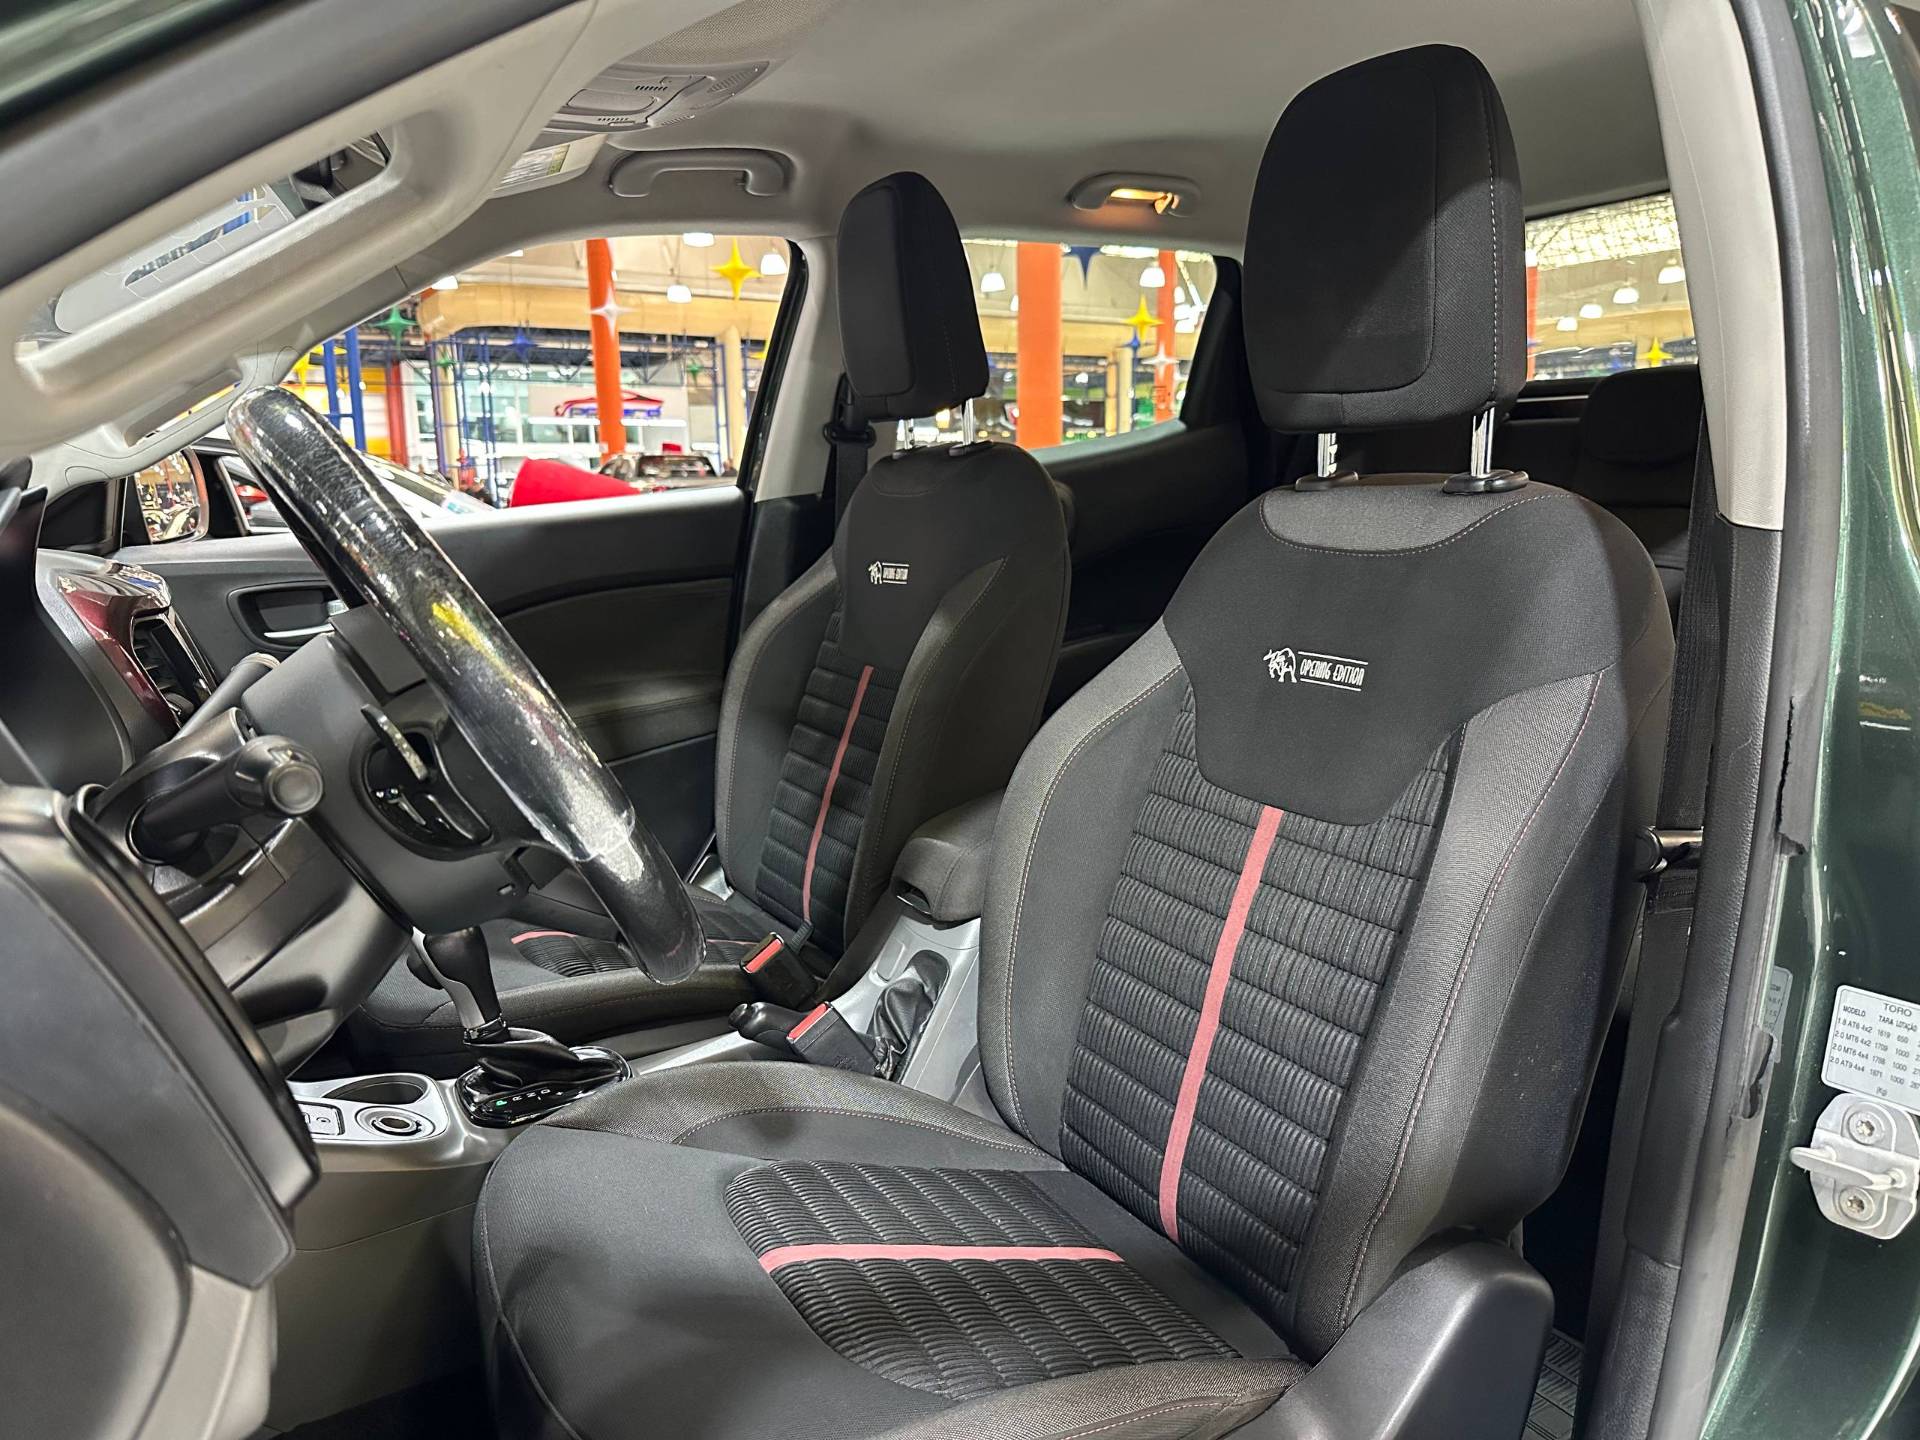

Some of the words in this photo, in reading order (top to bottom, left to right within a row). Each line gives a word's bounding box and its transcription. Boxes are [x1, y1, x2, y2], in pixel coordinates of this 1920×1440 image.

[1300, 658, 1332, 680] OPENING
[1332, 664, 1365, 686] EDITION
[1843, 1005, 1866, 1017] MODELO
[1884, 1003, 1912, 1017] TORO
[1879, 1015, 1893, 1025] TARA
[1861, 1024, 1873, 1032] 4x2
[1834, 1030, 1844, 1038] 2.0
[1845, 1033, 1859, 1042] MT6
[1860, 1038, 1872, 1046] 4x2
[1895, 1048, 1910, 1057] 1000
[1830, 1056, 1840, 1064] 2.0
[1840, 1060, 1853, 1068] AT9
[1854, 1063, 1865, 1071] 4x4
[1832, 1043, 1842, 1051] 2.0
[1843, 1046, 1857, 1055] MT6
[1857, 1051, 1869, 1059] 4x4
[1893, 1061, 1907, 1071] 1000
